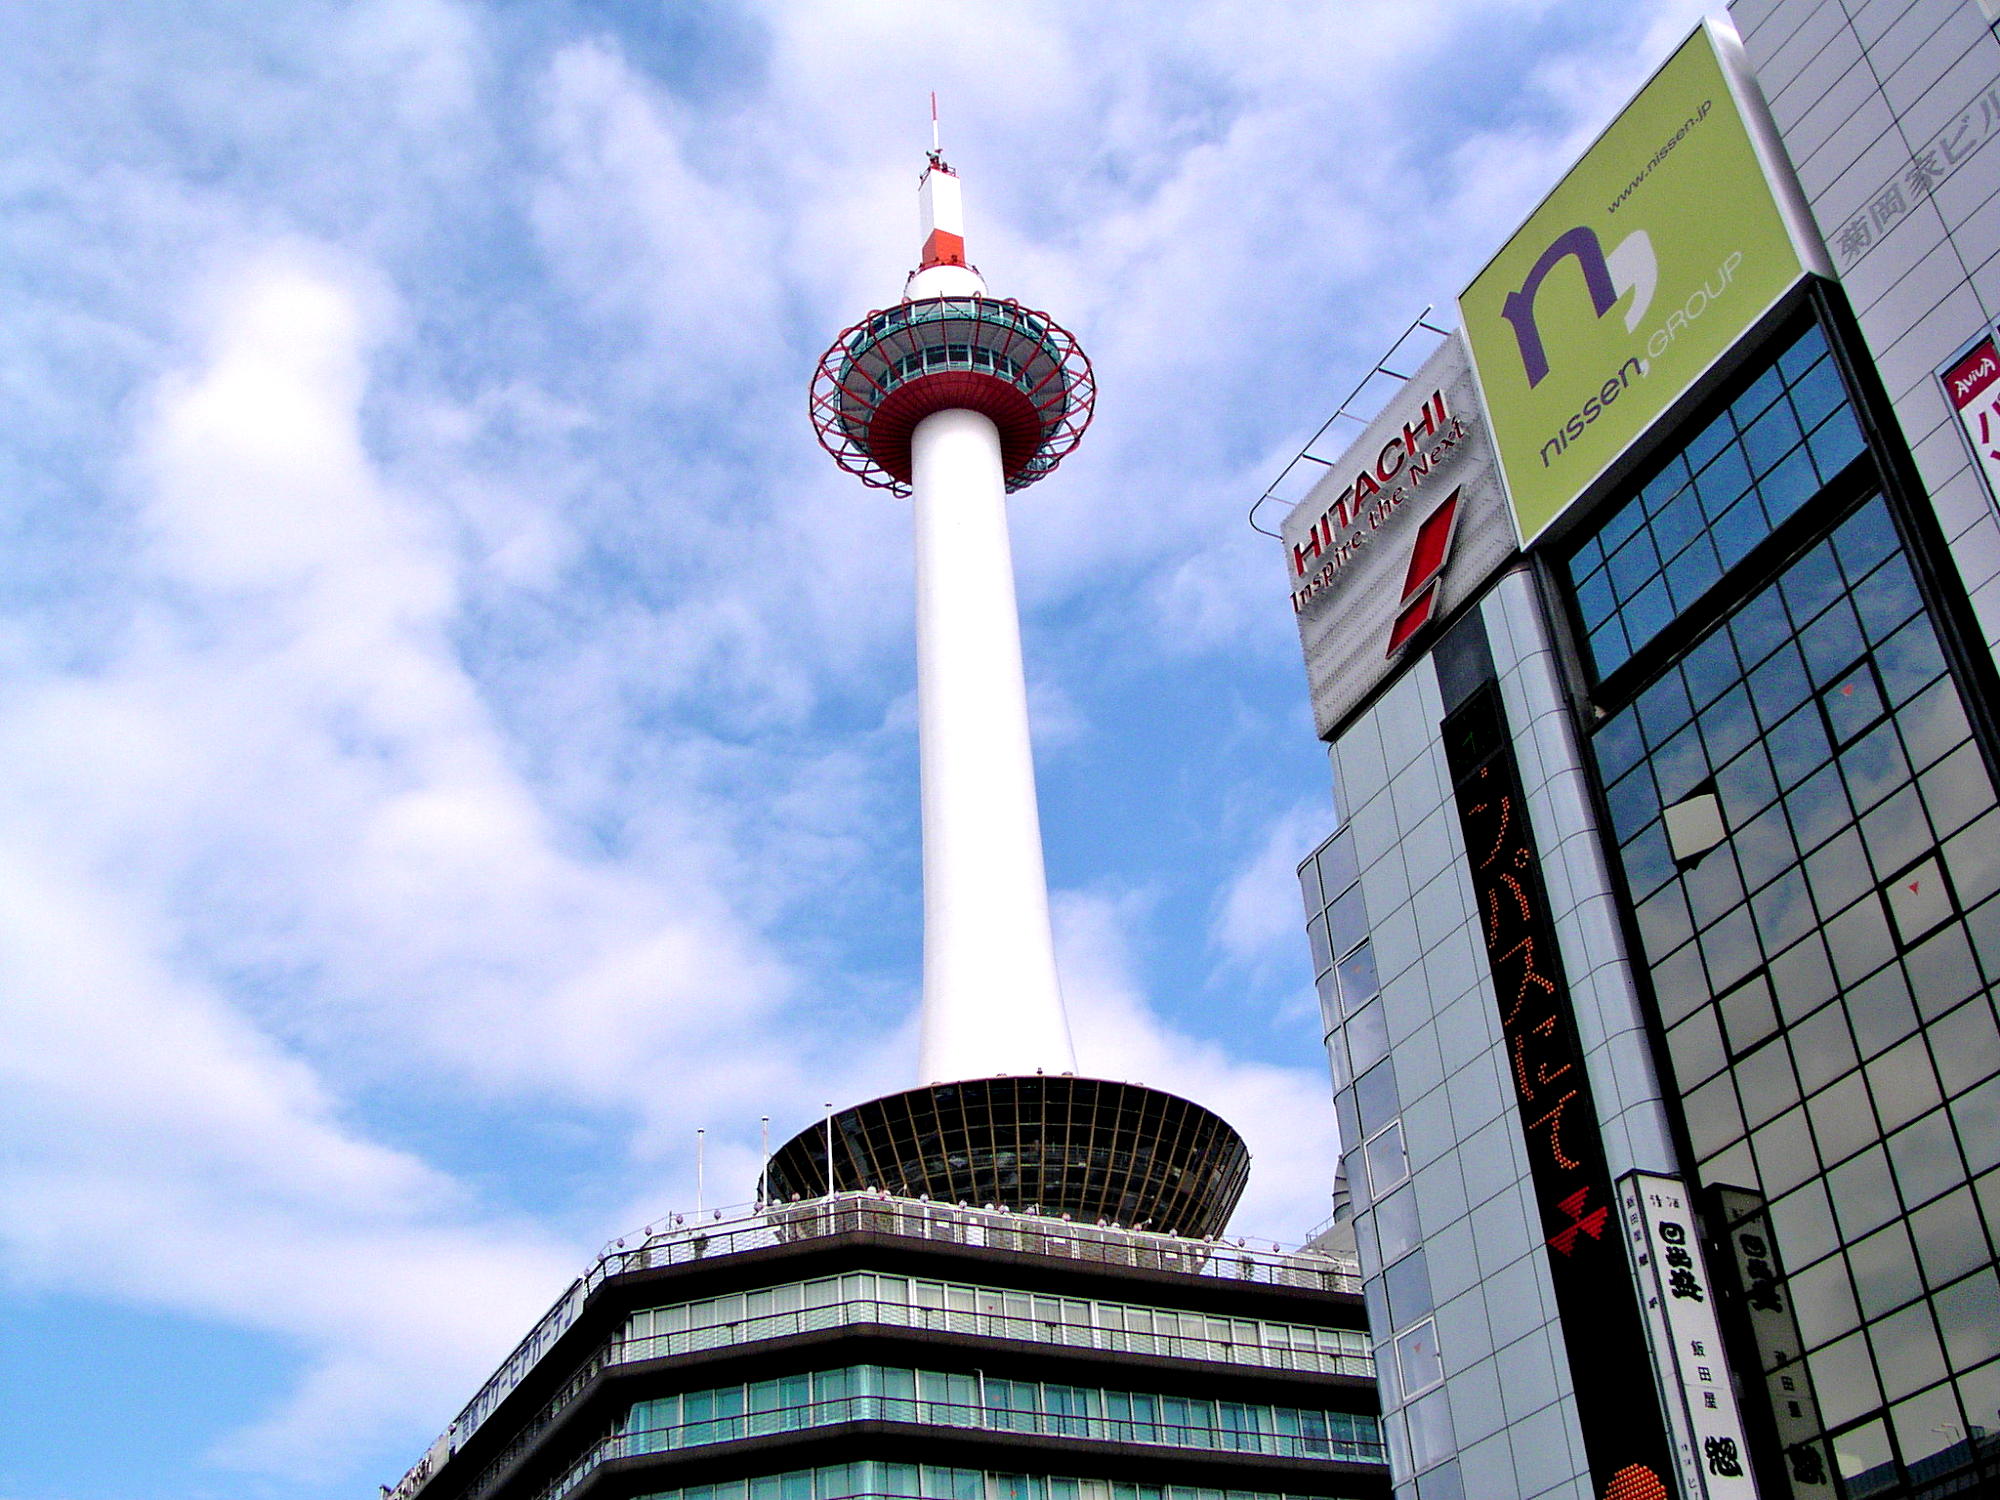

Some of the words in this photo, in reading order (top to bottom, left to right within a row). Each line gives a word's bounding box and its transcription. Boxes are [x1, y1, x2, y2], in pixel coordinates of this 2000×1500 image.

[1608, 100, 1712, 213] www.nissen.jp
[1647, 251, 1742, 358] GROUP
[1290, 530, 1366, 614] Inspire
[1368, 486, 1408, 531] the
[1409, 415, 1467, 487] Next
[1292, 389, 1451, 578] HITACHI
[1468, 767, 1580, 1169] ンパスにて
